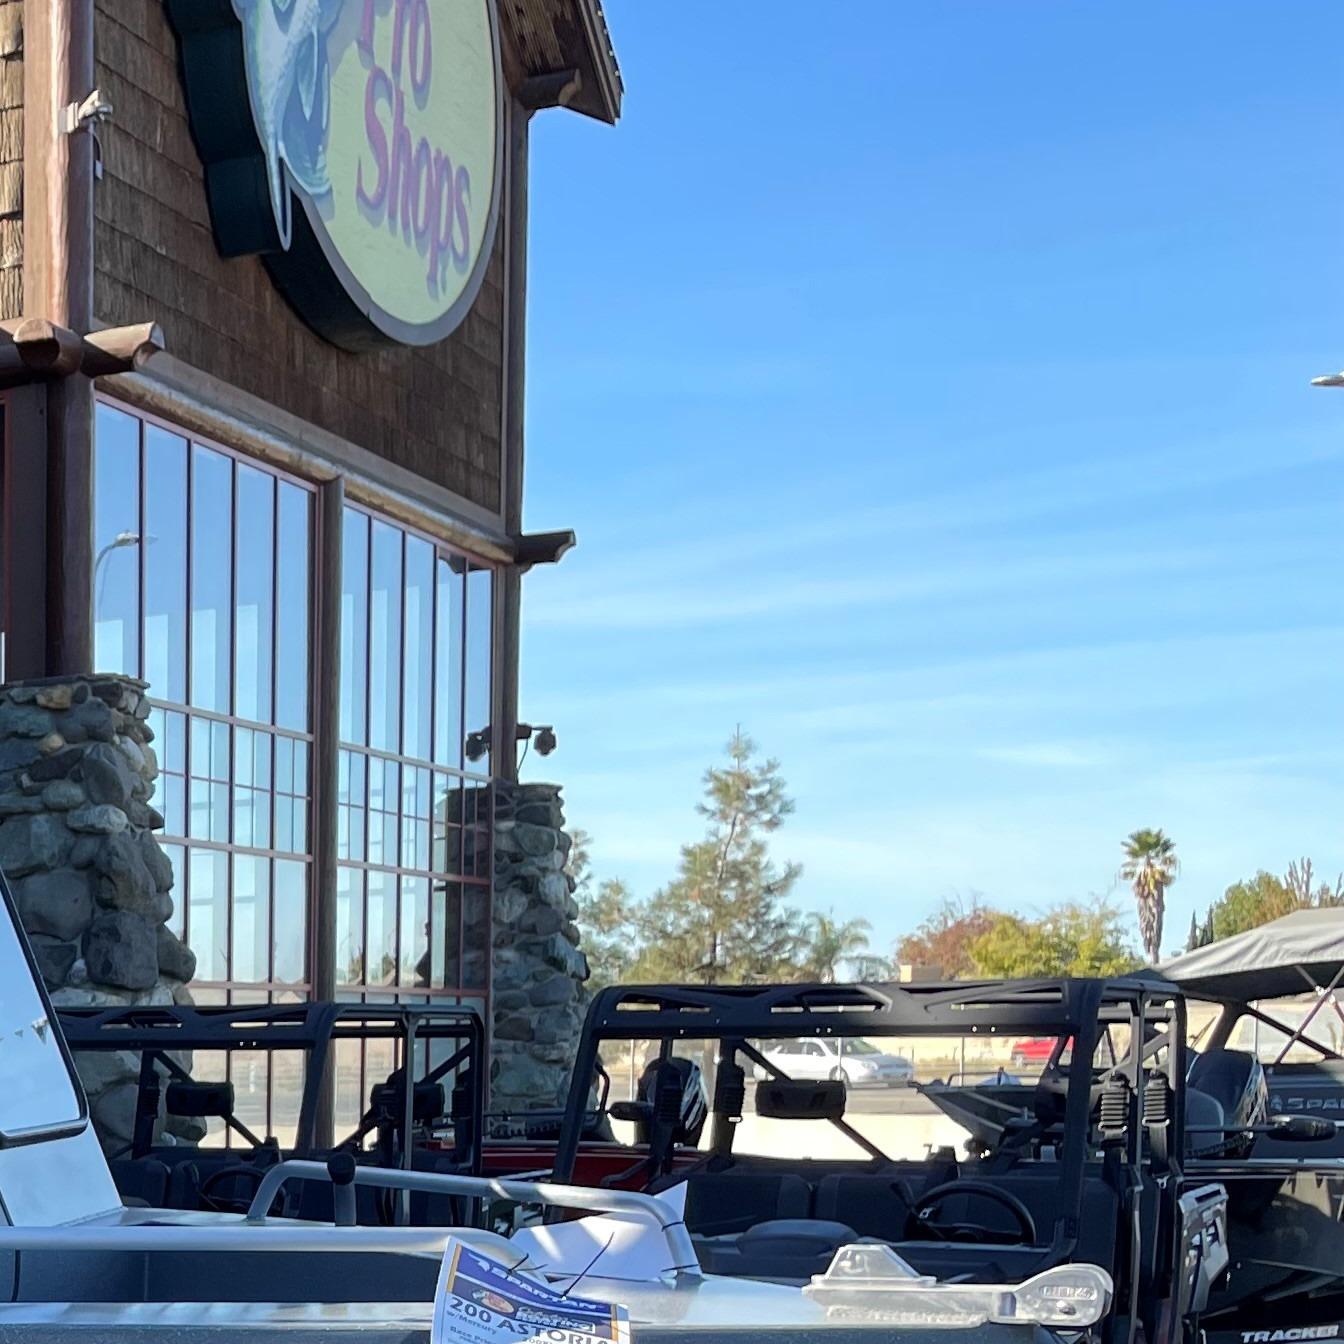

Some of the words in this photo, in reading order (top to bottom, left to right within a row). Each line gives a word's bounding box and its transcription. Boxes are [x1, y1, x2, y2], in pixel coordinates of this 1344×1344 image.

[355, 65, 472, 286] Shops
[1286, 1097, 1344, 1110] SPA
[449, 1296, 492, 1324] 200
[1241, 1324, 1339, 1344] TRACKER
